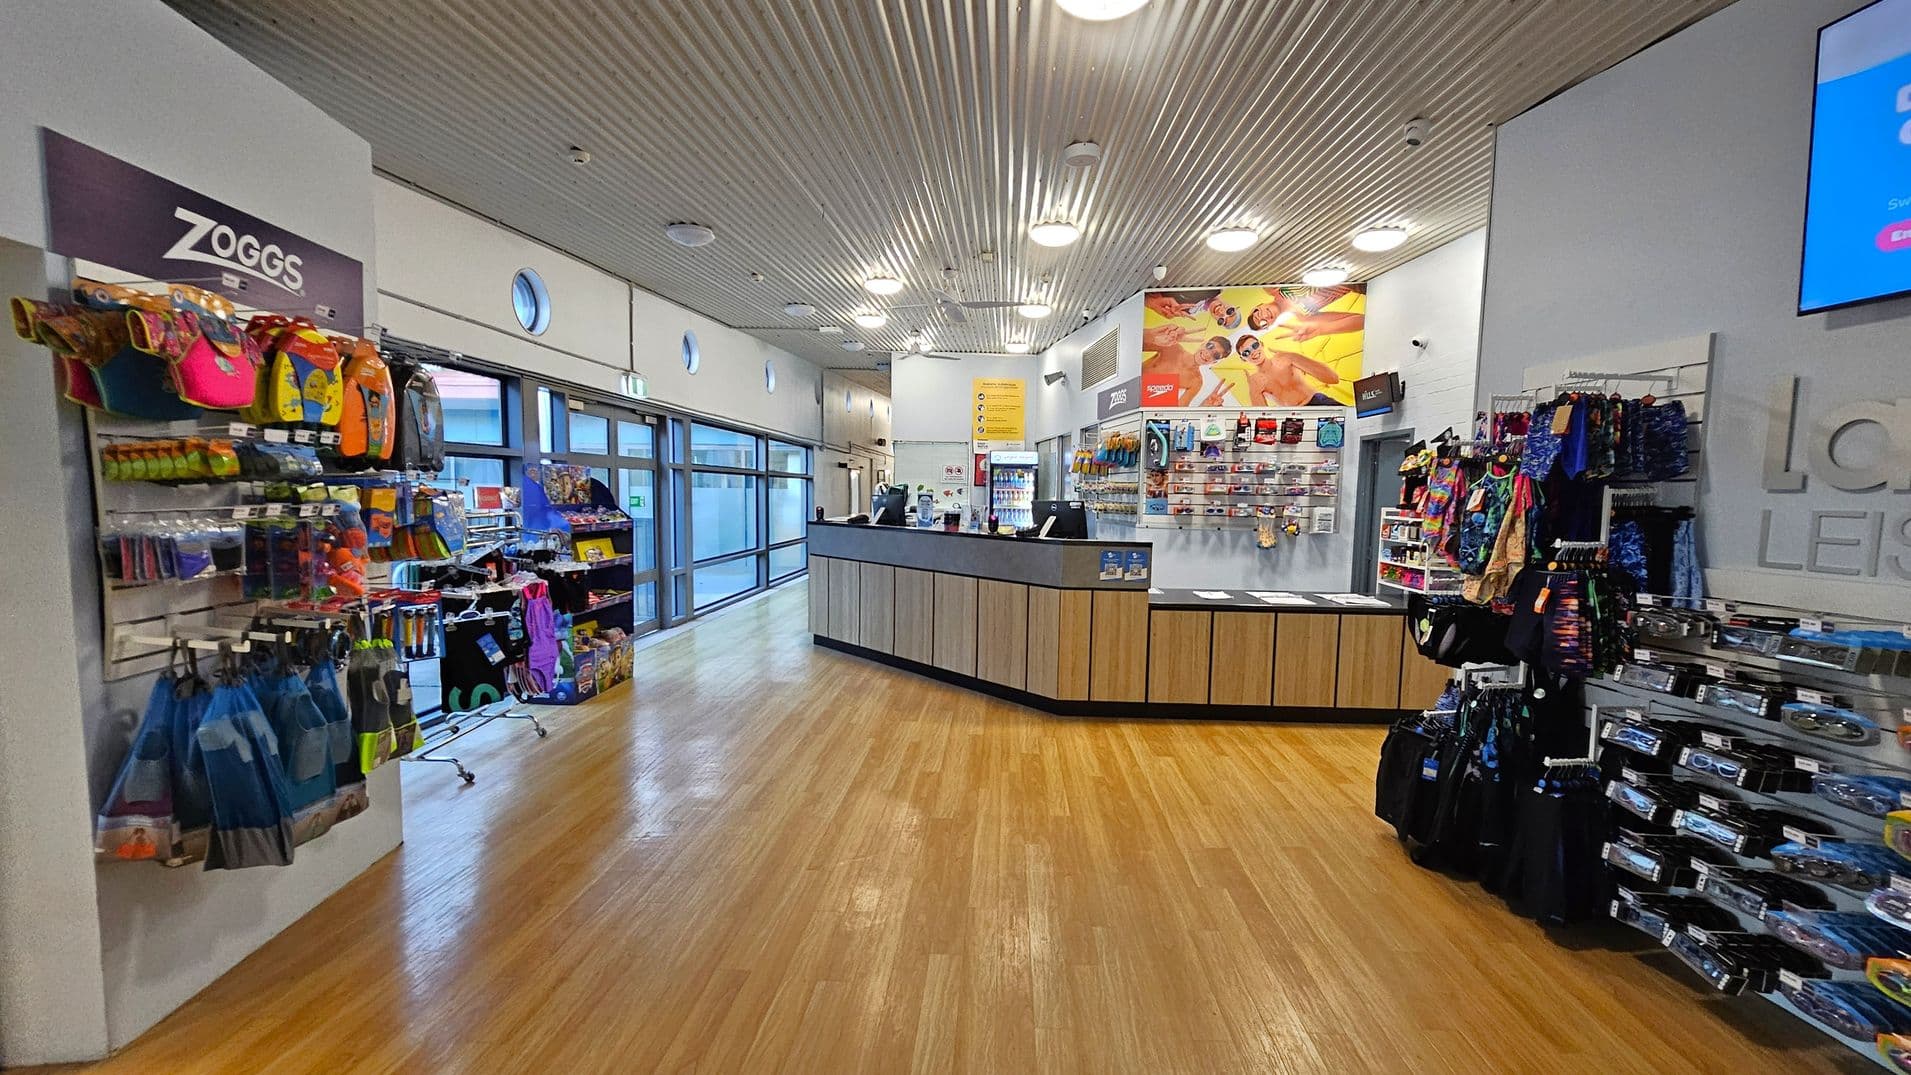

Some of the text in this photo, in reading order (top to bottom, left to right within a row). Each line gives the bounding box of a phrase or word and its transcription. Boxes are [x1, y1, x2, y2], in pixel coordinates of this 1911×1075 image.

[163, 206, 303, 297] ZOGGS
[1108, 388, 1128, 410] ZOGGS
[1147, 384, 1175, 395] speedo
